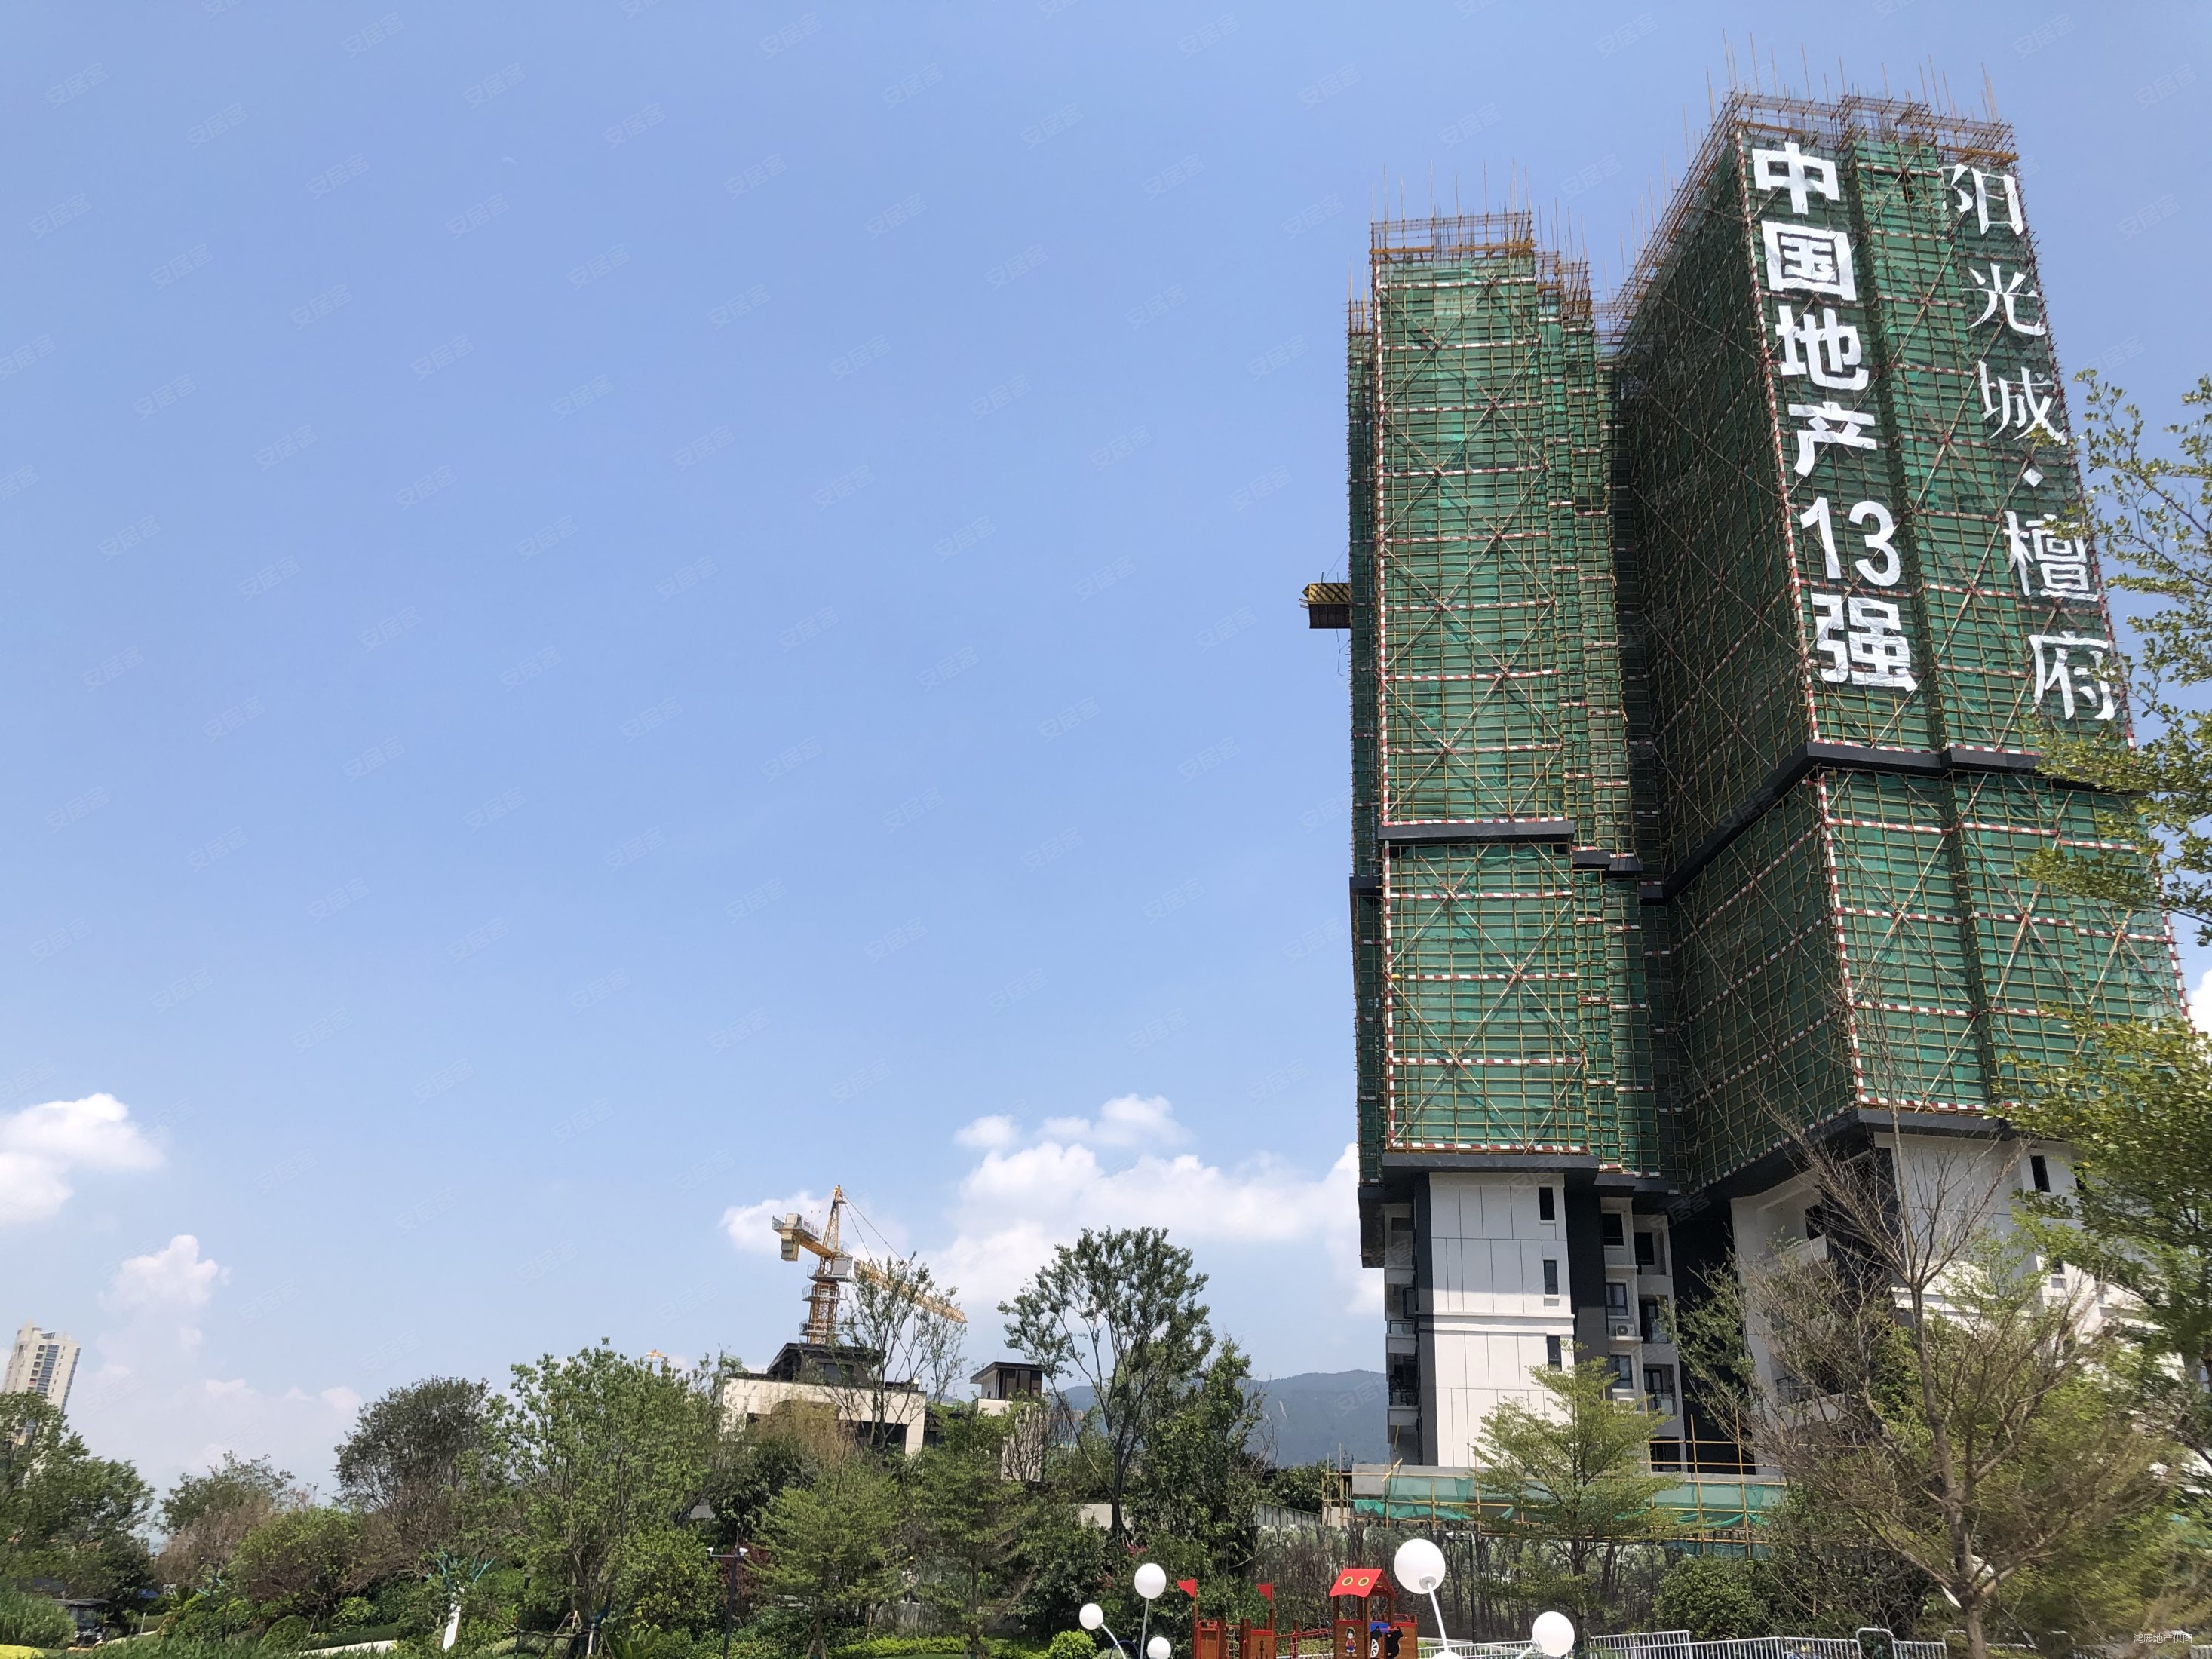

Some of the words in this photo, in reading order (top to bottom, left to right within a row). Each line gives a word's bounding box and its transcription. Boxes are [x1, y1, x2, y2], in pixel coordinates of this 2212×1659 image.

[1752, 142, 1918, 692] 中国地产13强
[1941, 163, 2120, 721] 阳光城·檀府
